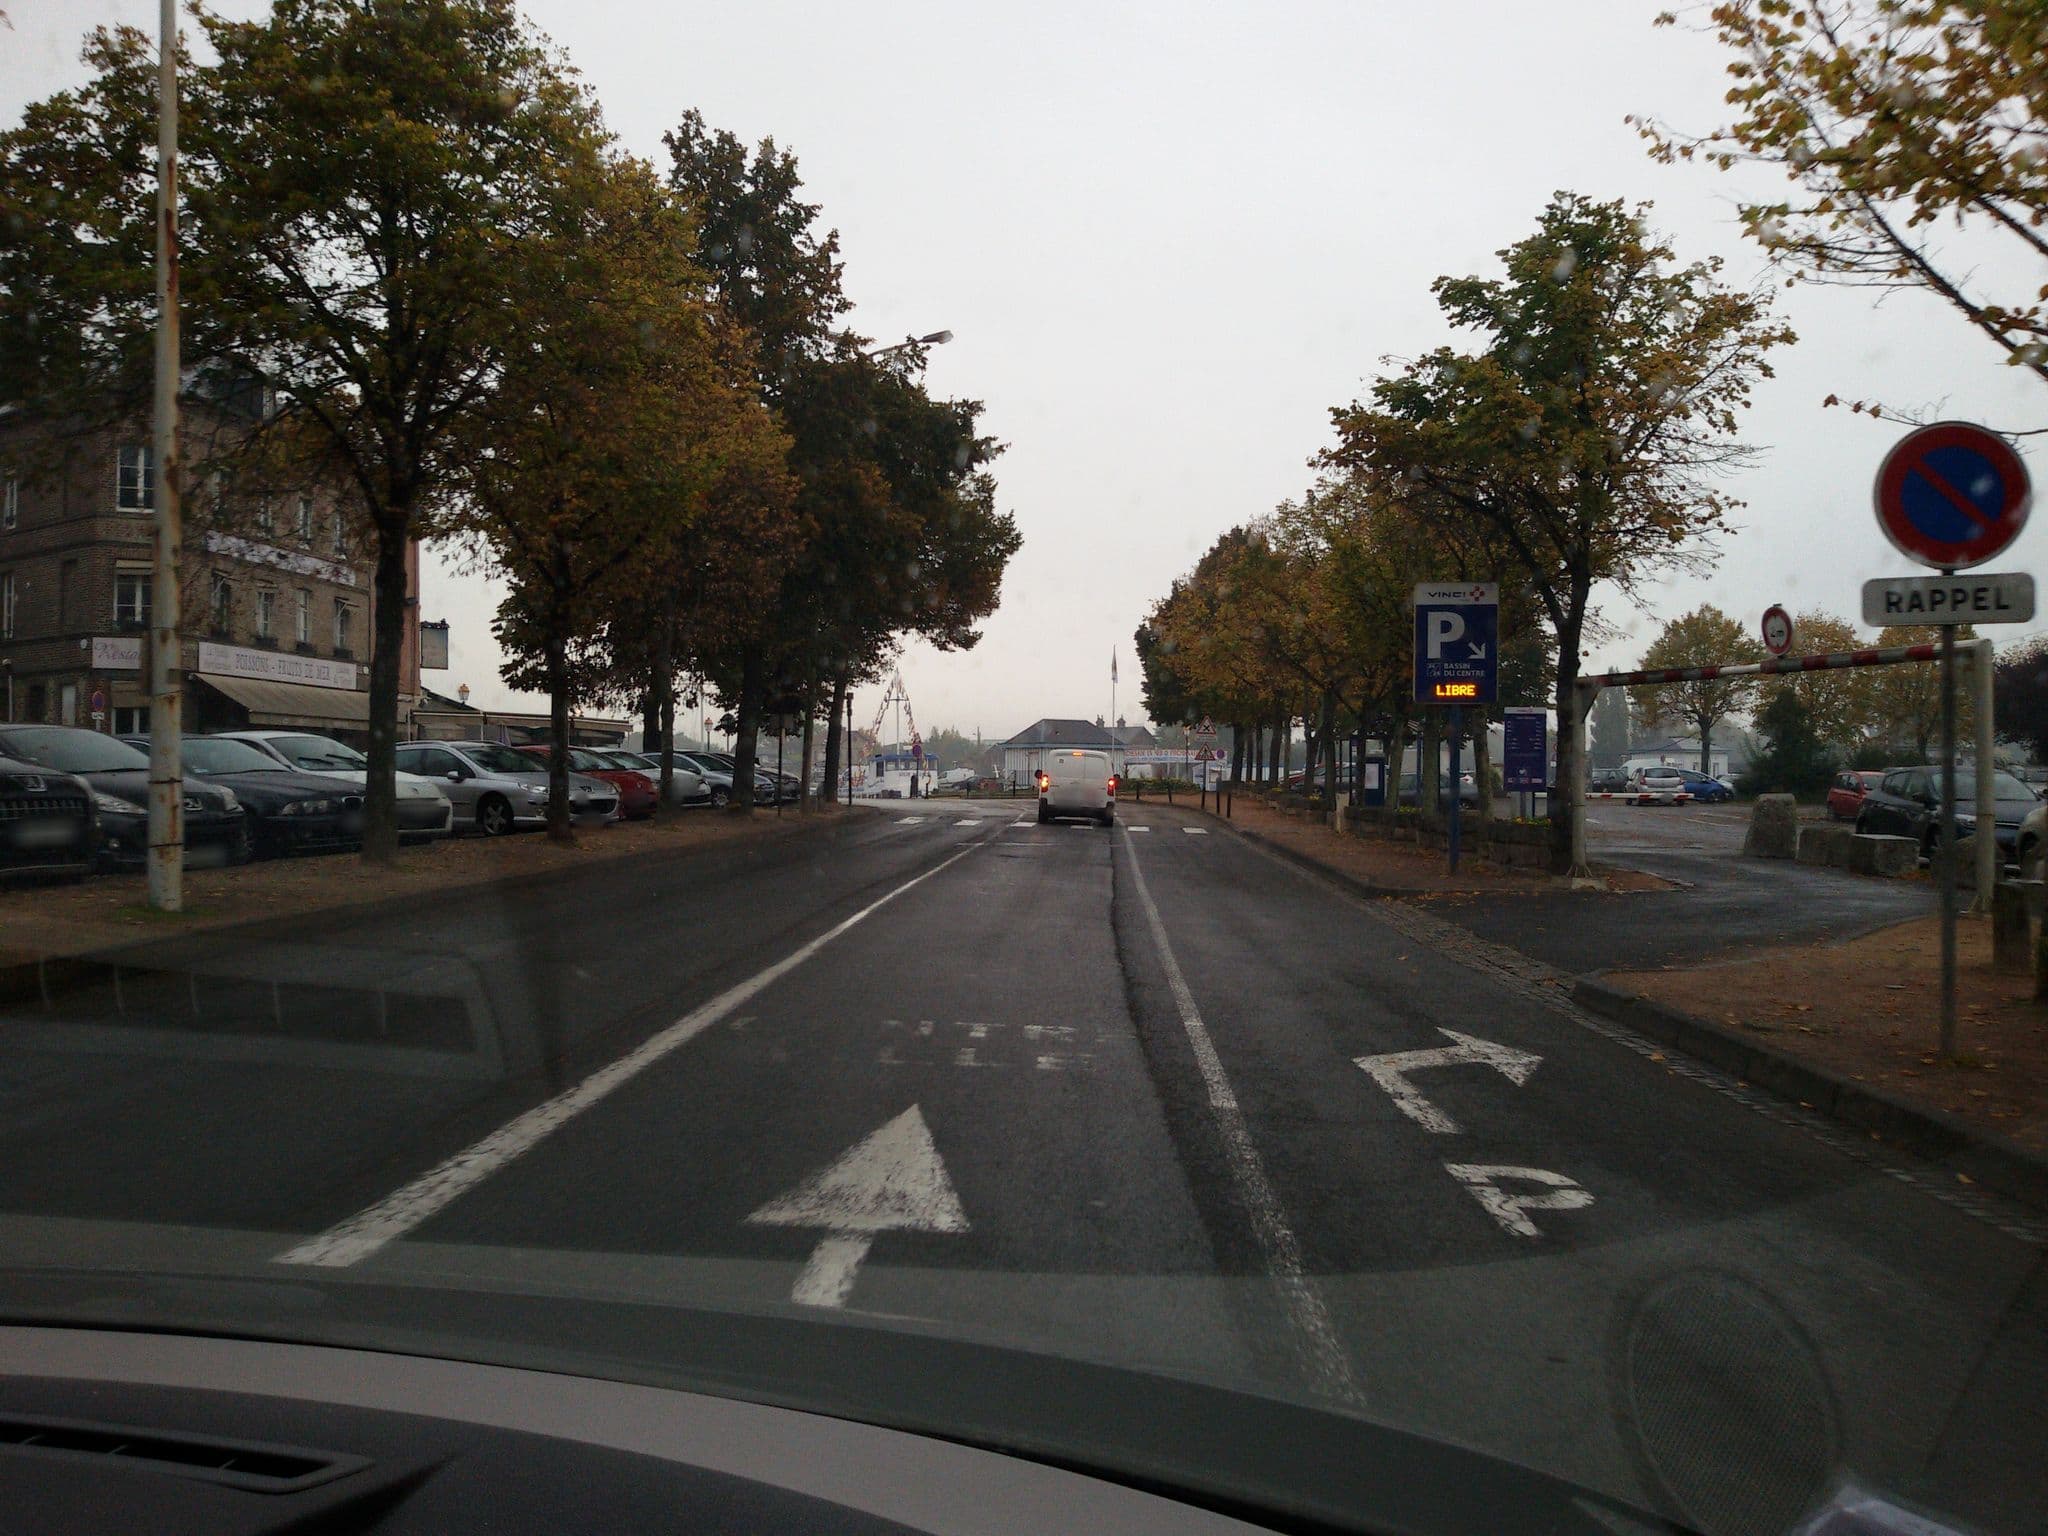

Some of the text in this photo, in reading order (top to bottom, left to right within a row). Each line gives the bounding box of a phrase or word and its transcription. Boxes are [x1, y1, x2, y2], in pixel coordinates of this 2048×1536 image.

[1885, 587, 2010, 613] RAPPEL
[1427, 611, 1465, 659] P
[235, 653, 269, 673] POISSONS
[278, 659, 302, 677] FRUITS
[305, 663, 313, 679] DE
[316, 664, 331, 681] MER
[1435, 684, 1476, 697] LIBRE
[1443, 1163, 1596, 1237] P
